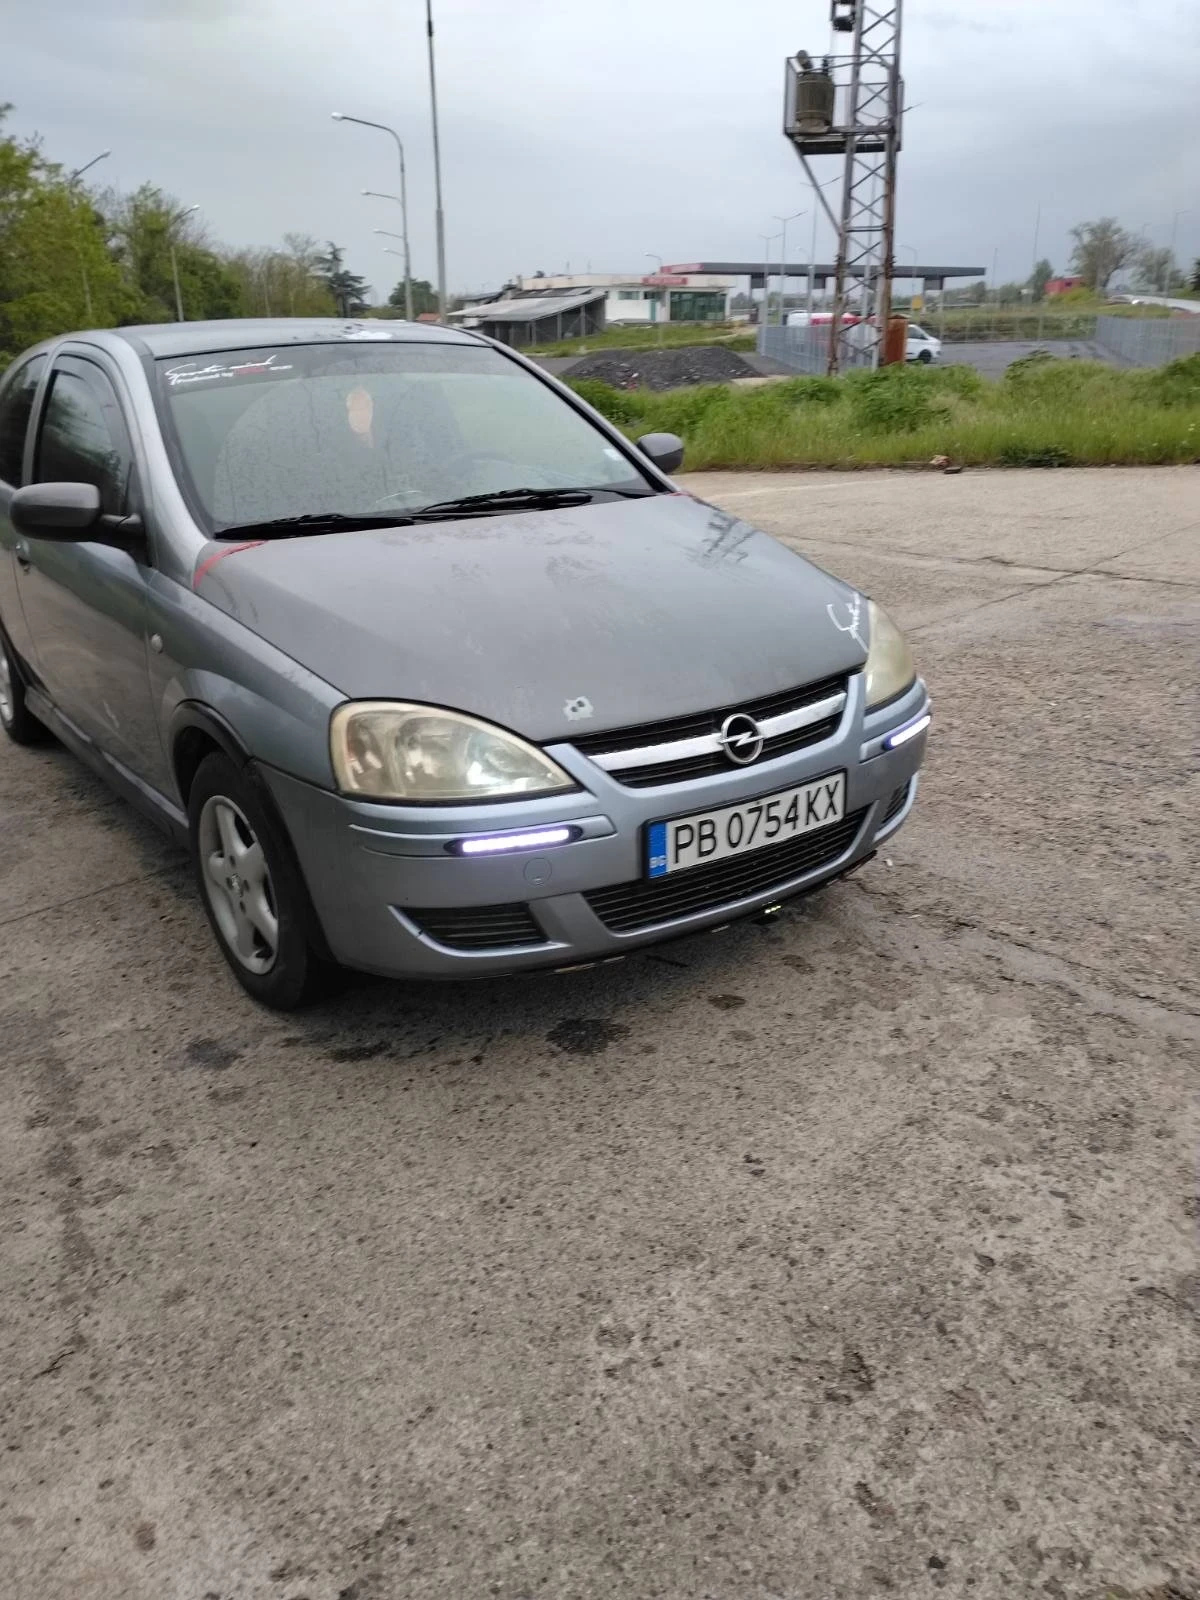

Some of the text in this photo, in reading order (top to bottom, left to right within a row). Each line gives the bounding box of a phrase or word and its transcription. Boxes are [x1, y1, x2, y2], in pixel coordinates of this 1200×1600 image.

[674, 780, 840, 864] PB 0754 KX
